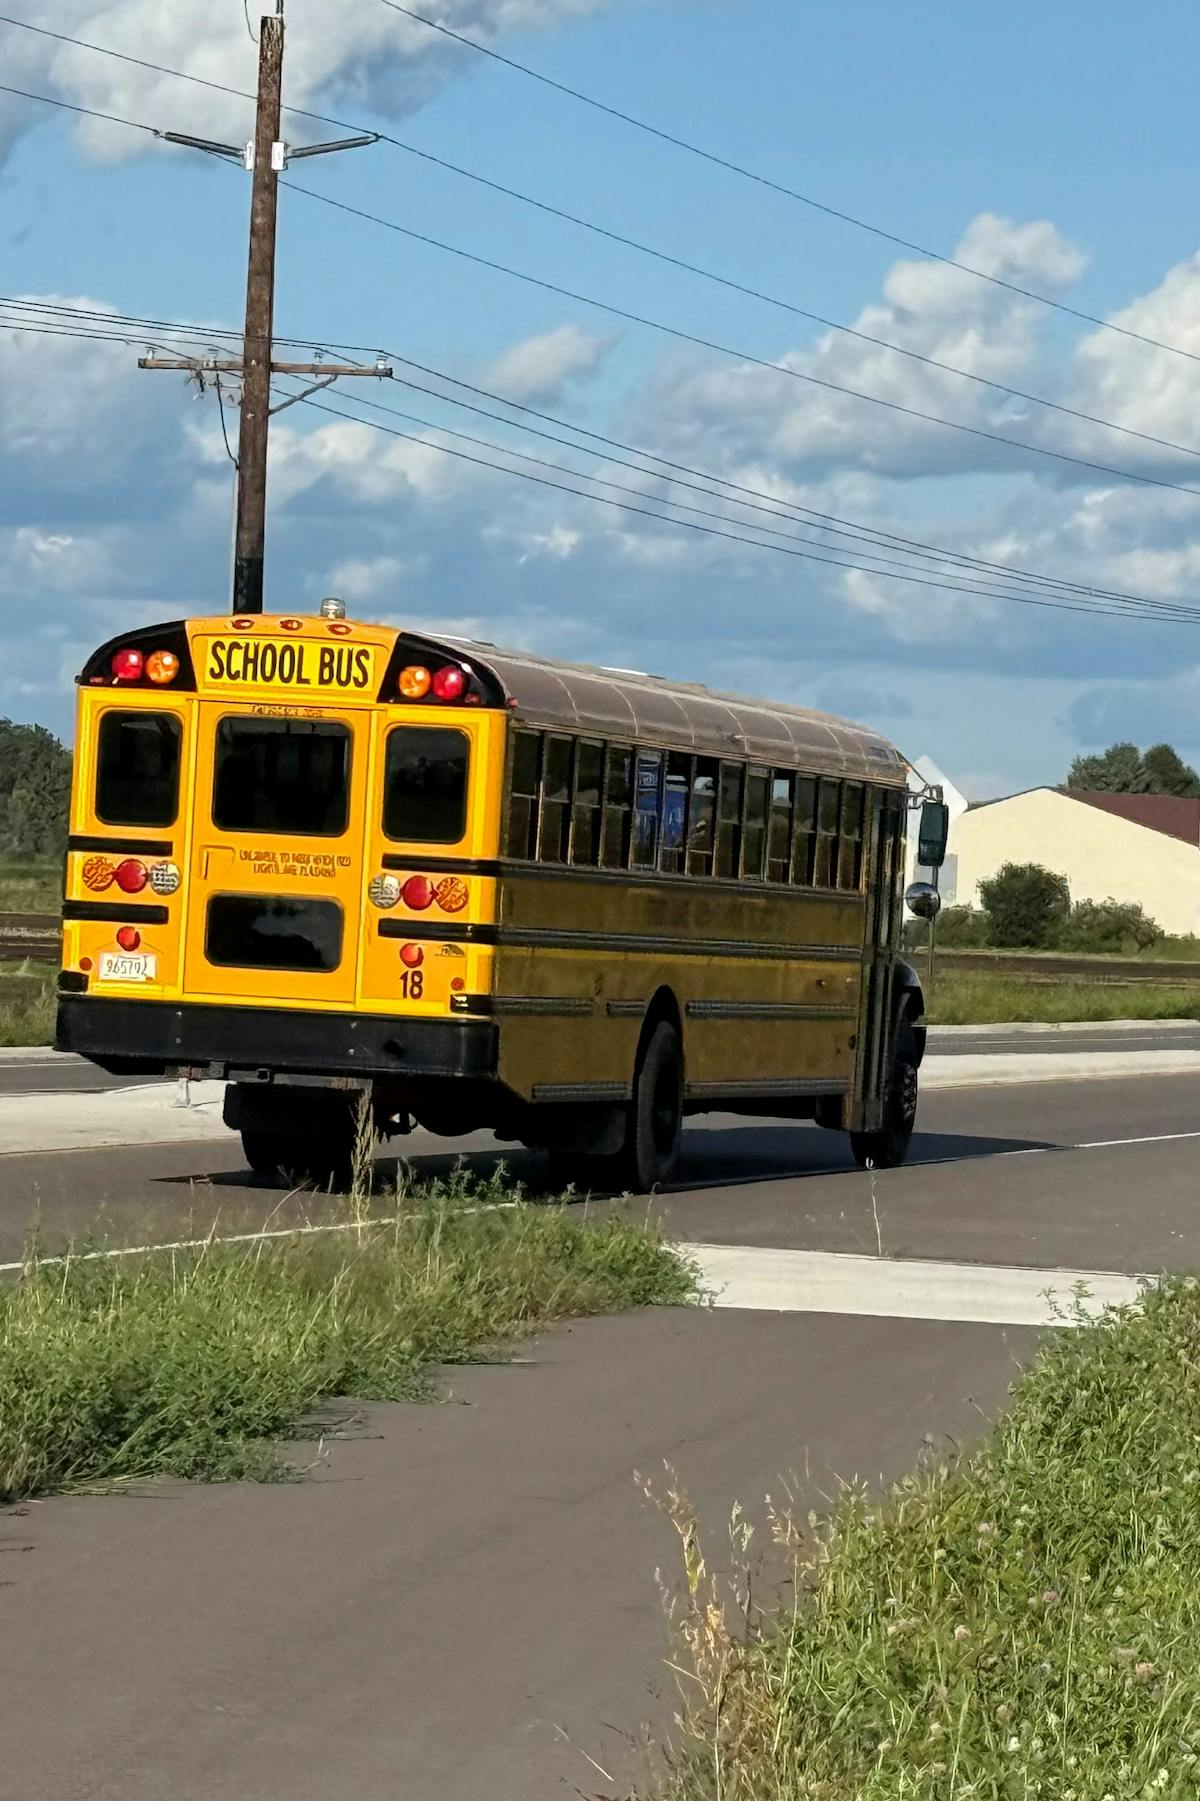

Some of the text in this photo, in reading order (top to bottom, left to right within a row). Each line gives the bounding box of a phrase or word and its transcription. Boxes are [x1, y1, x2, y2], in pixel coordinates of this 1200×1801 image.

[209, 640, 370, 688] SCHOOL BUS
[400, 970, 424, 1000] 18
